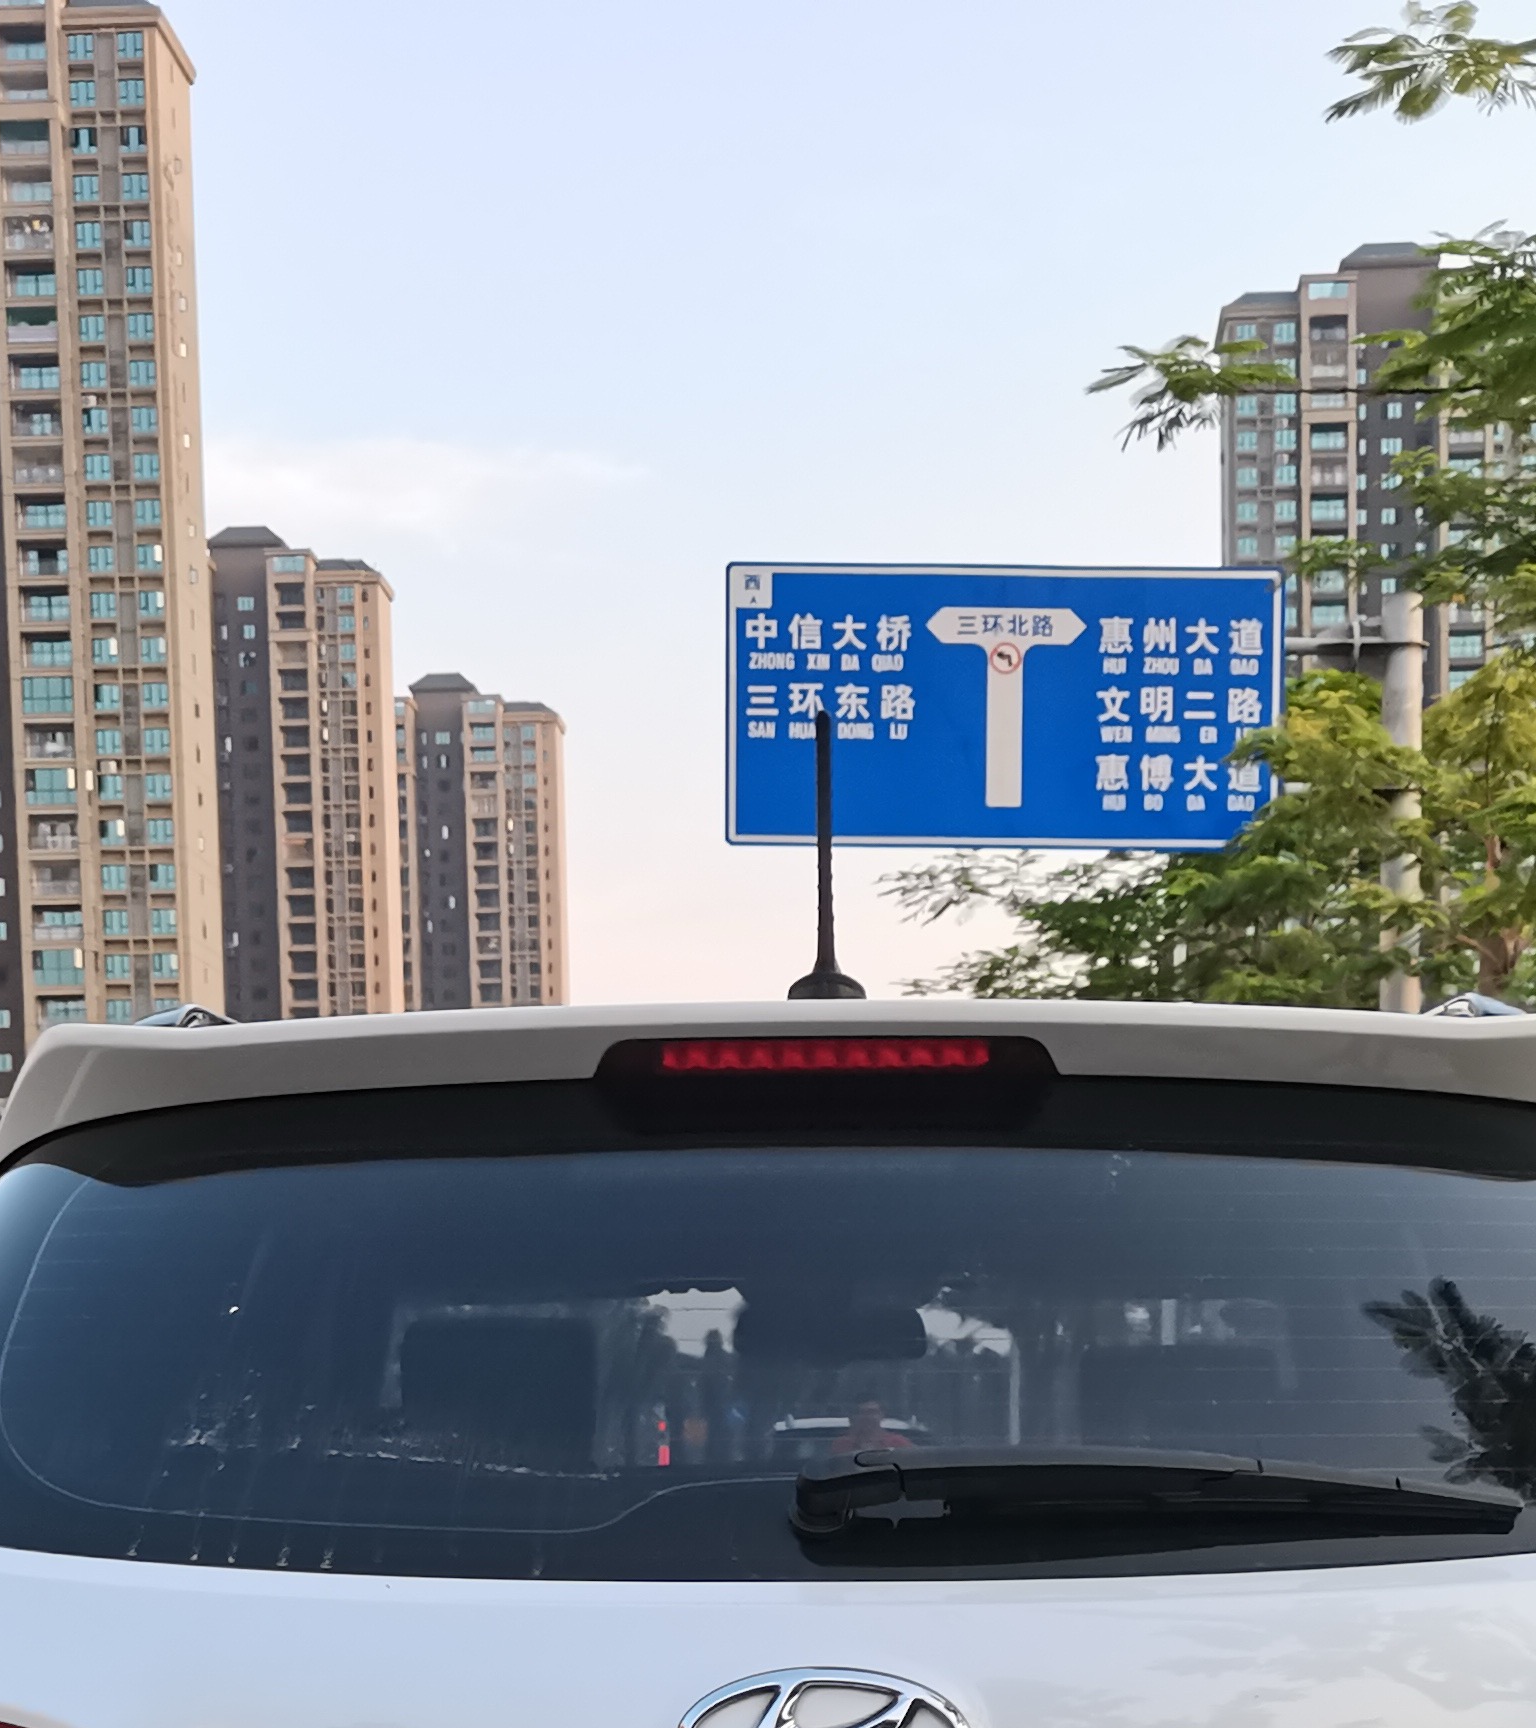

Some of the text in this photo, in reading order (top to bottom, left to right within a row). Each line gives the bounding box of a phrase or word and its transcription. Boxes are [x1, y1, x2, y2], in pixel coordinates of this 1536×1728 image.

[745, 613, 912, 651] 中信大桥
[957, 614, 1053, 637] 三环北路
[1099, 616, 1263, 656] 惠州大道
[749, 652, 795, 670] ZHONG
[807, 653, 830, 670] XIN
[840, 654, 860, 671] DA
[1143, 657, 1180, 675] ZHOU
[746, 683, 915, 720] 三环东路
[1096, 686, 1262, 724] 文明二路
[748, 721, 776, 739] SAN
[789, 721, 817, 739] HUA
[889, 723, 908, 740] LU
[1095, 754, 1262, 792] 惠博大道
